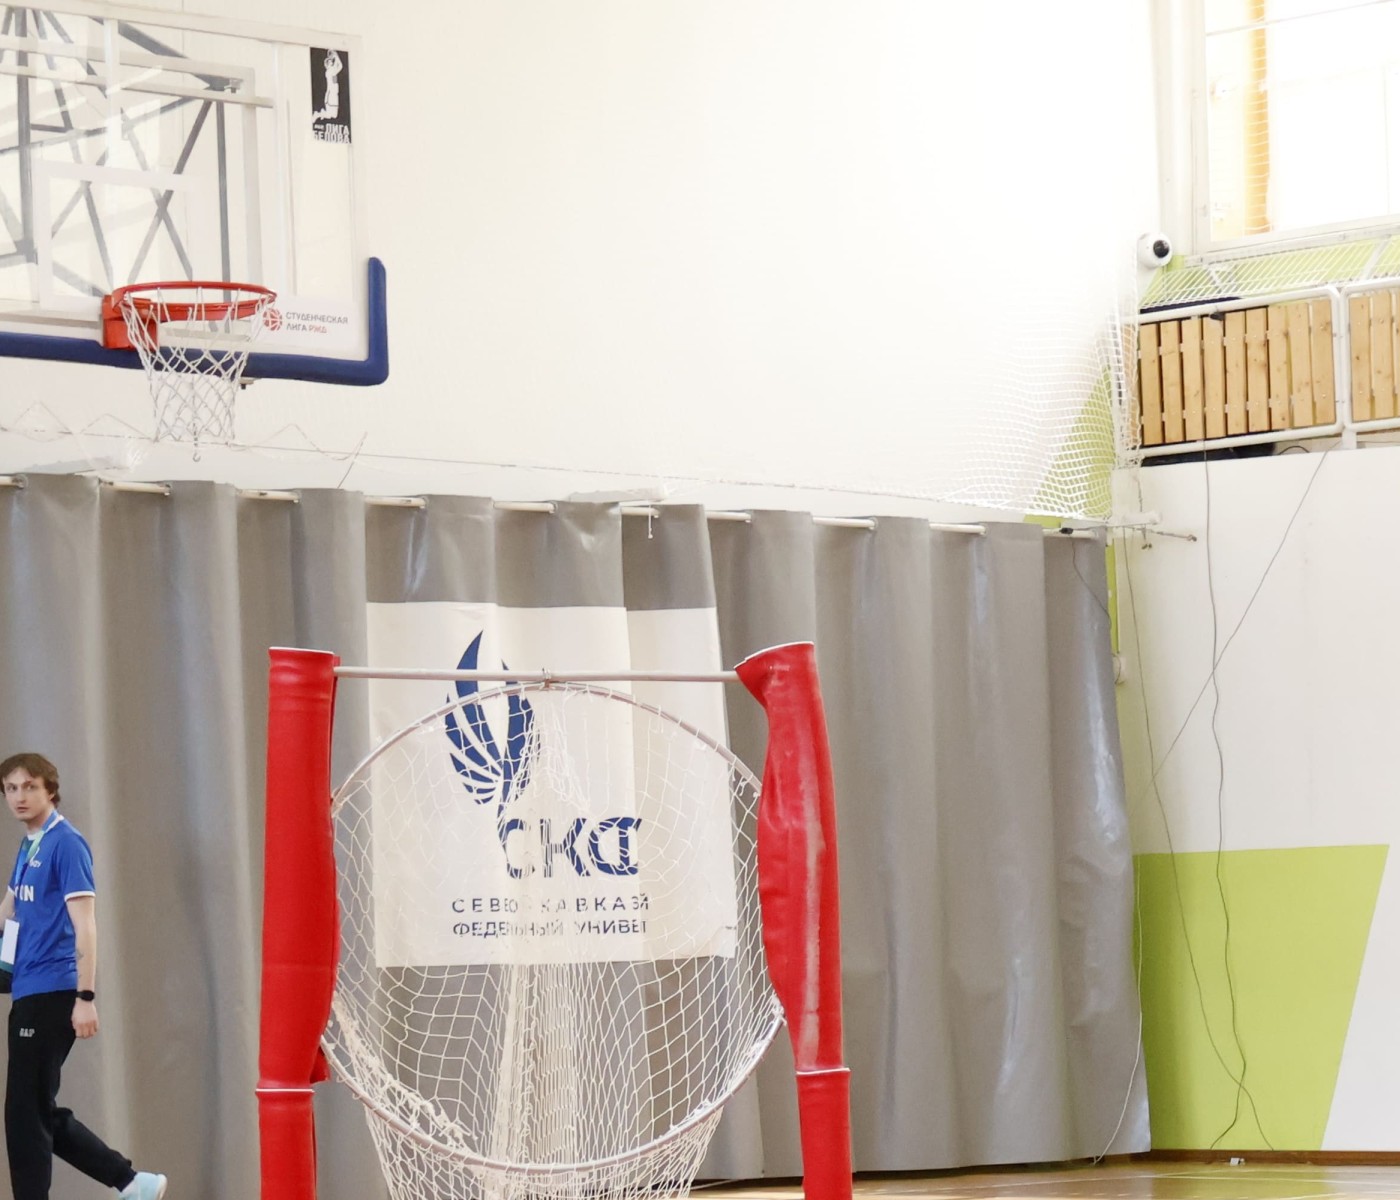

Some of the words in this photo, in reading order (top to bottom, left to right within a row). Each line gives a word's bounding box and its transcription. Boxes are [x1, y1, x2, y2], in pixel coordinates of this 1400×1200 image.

[285, 312, 348, 324] СТУДЕНЧЕСКАЯ
[286, 323, 307, 332] ЛИГА
[309, 325, 327, 333] РЖД
